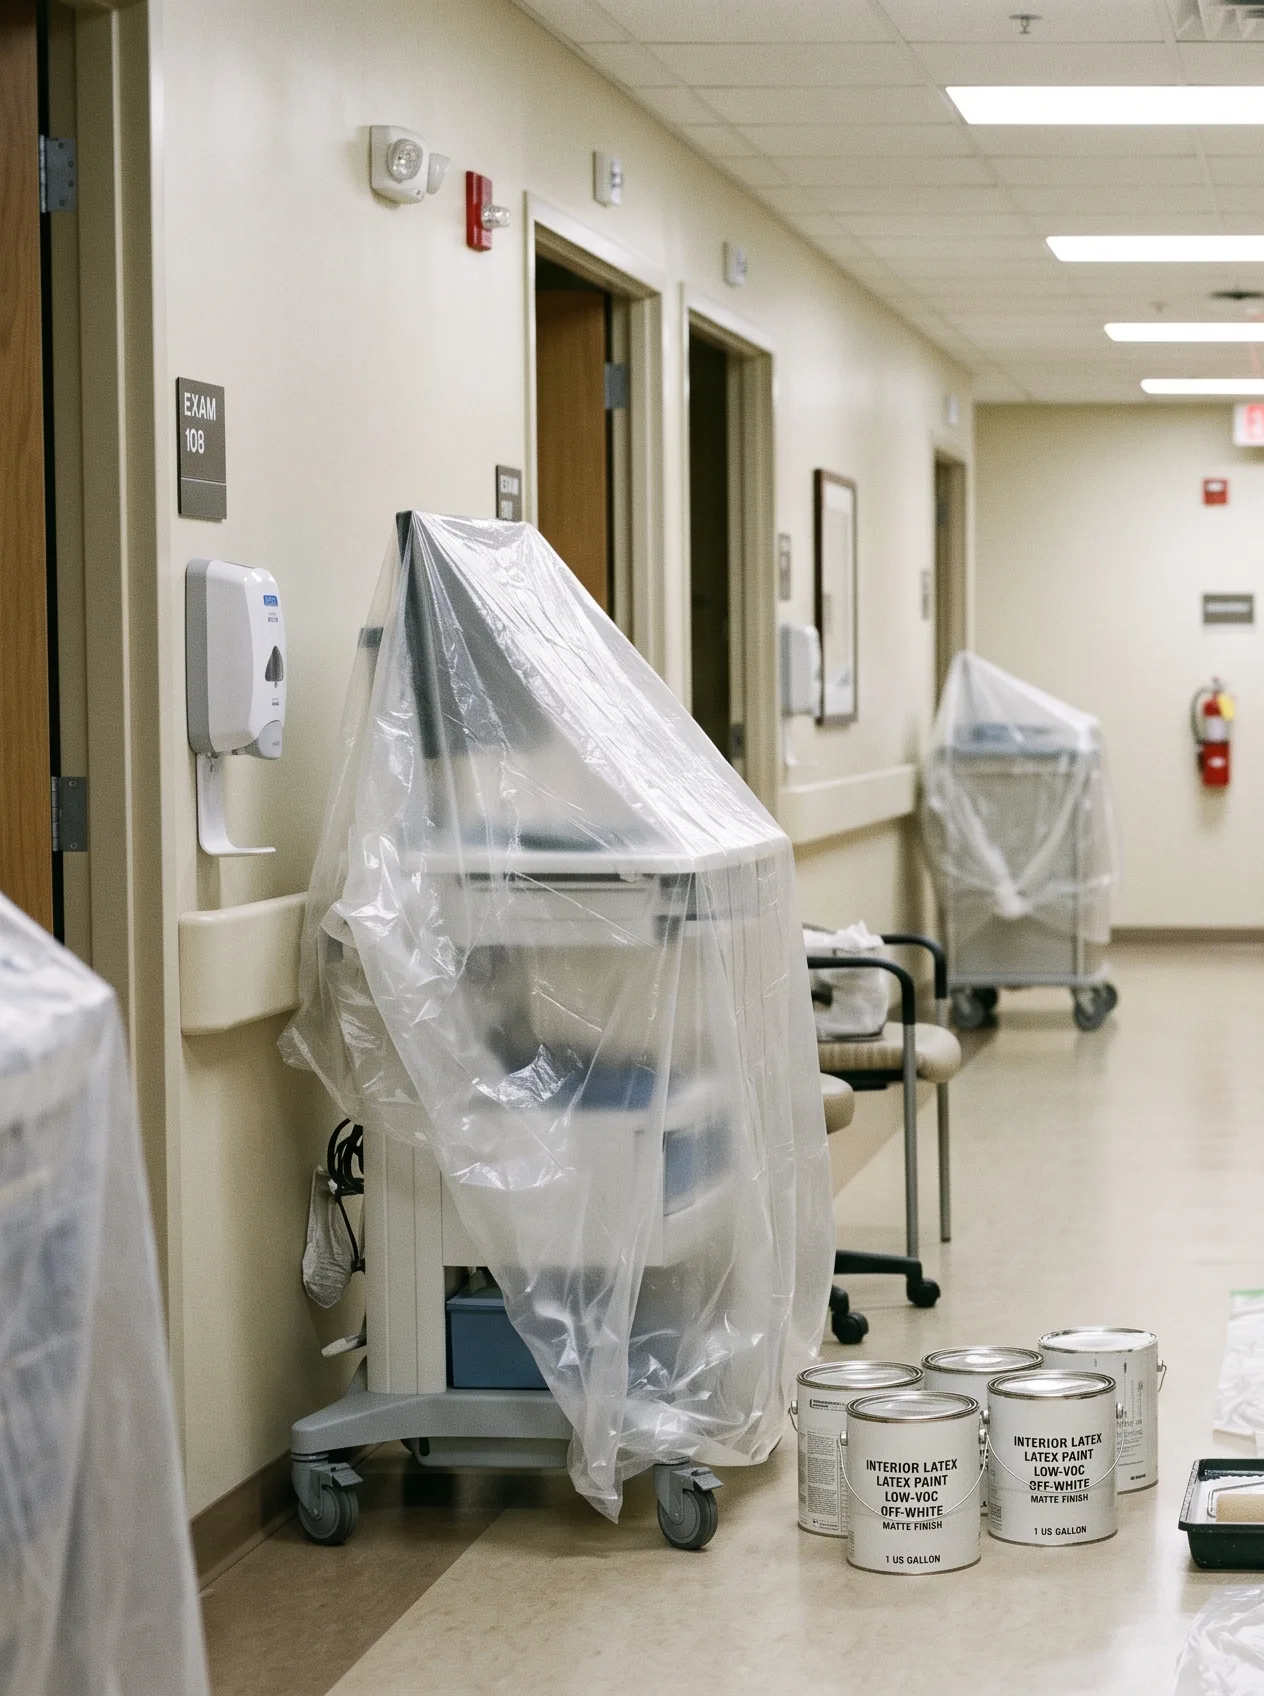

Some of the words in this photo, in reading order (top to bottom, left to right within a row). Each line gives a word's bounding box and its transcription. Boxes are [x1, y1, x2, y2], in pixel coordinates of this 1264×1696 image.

[184, 391, 216, 421] EXAM
[185, 427, 205, 454] 108
[1014, 1436, 1068, 1448] INTERIOR
[1071, 1433, 1102, 1447] LATEX
[1024, 1451, 1058, 1463] LATEX
[1062, 1449, 1094, 1462] PAINT
[866, 1459, 920, 1474] INTERIOR
[923, 1459, 958, 1473] LATEX
[1034, 1465, 1085, 1477] LOW-VOC
[876, 1475, 911, 1488] LATEX
[914, 1474, 949, 1488] PAINT
[1029, 1478, 1090, 1491] OFF-WHITE
[885, 1491, 938, 1503] LOW-VOC
[1030, 1495, 1059, 1504] MATTE
[1062, 1493, 1089, 1503] FINISH
[881, 1505, 943, 1518] OFF-WHITE
[882, 1521, 911, 1531] MATTE
[914, 1521, 943, 1531] FINISH
[1034, 1527, 1038, 1535] 1
[1041, 1527, 1052, 1536] US
[1055, 1525, 1087, 1536] GALLON
[885, 1555, 889, 1563] 1
[892, 1556, 904, 1564] US
[906, 1555, 941, 1564] GALLON
